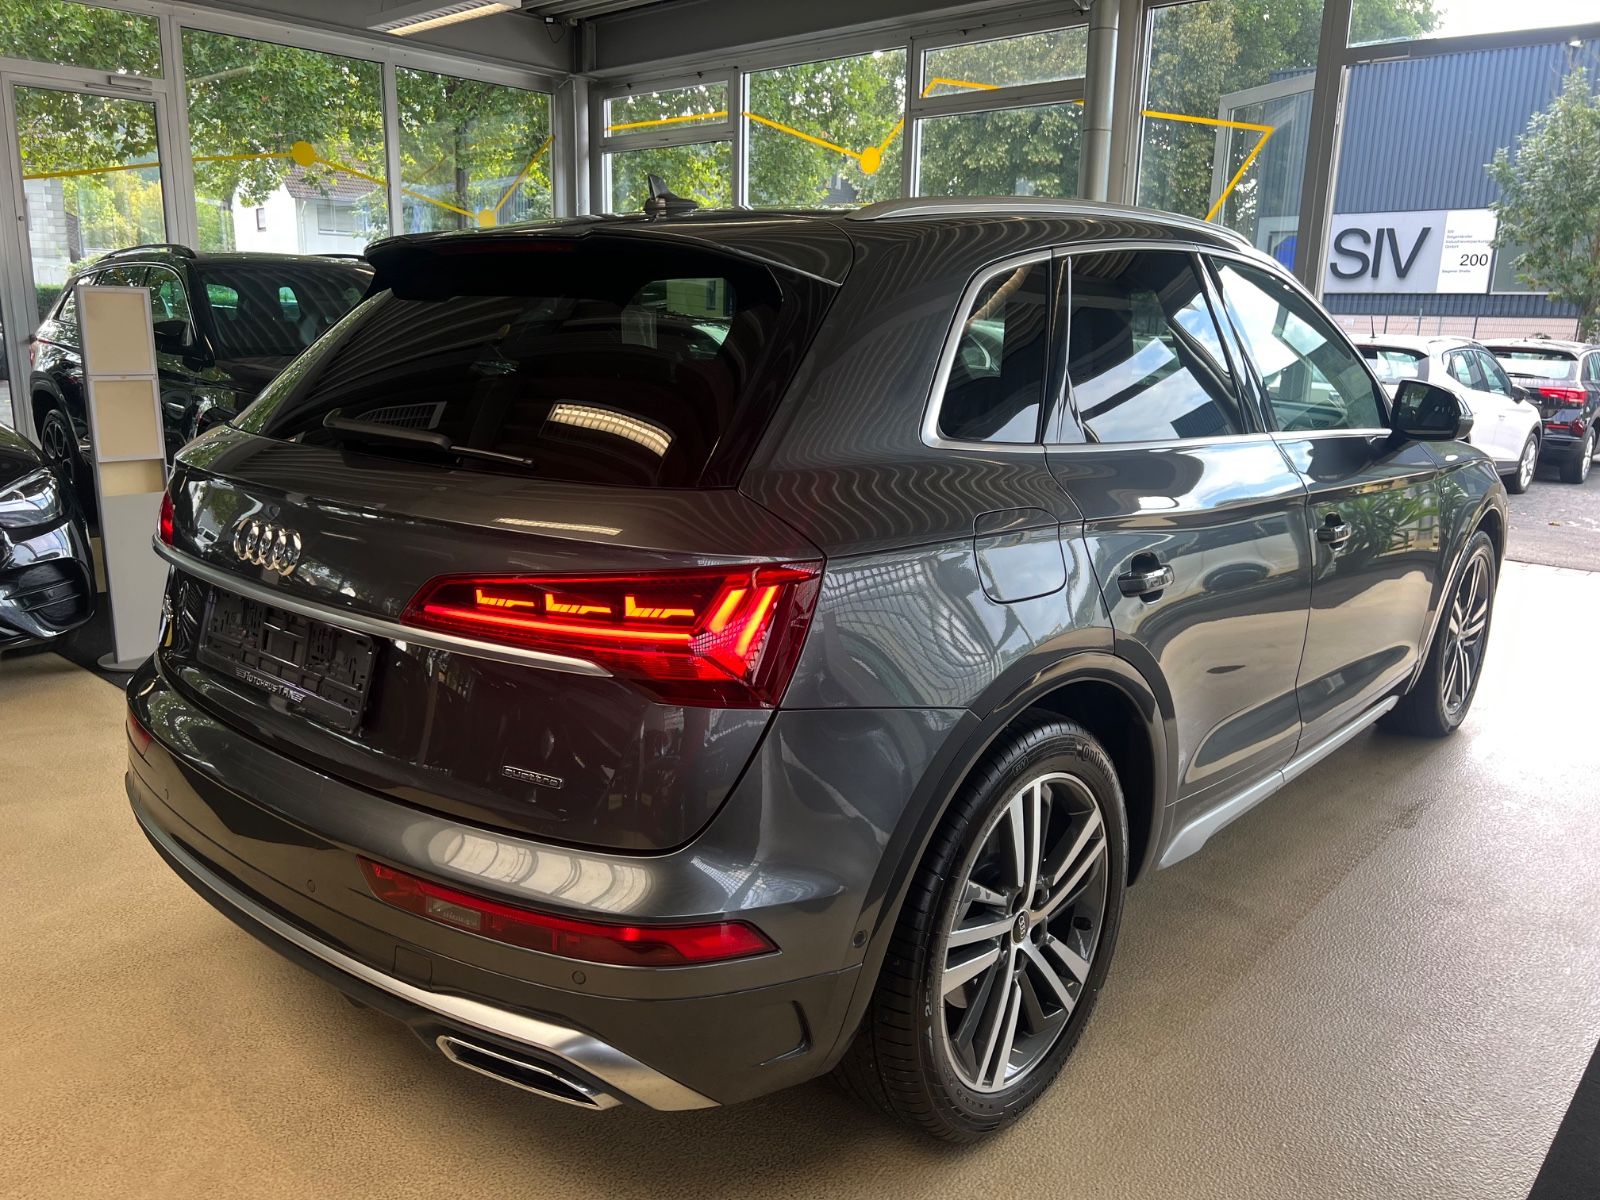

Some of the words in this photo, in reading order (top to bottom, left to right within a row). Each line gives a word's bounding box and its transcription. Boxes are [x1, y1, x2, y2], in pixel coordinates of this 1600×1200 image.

[1330, 227, 1432, 279] SIV
[1459, 253, 1489, 267] 200
[504, 768, 559, 787] quattro
